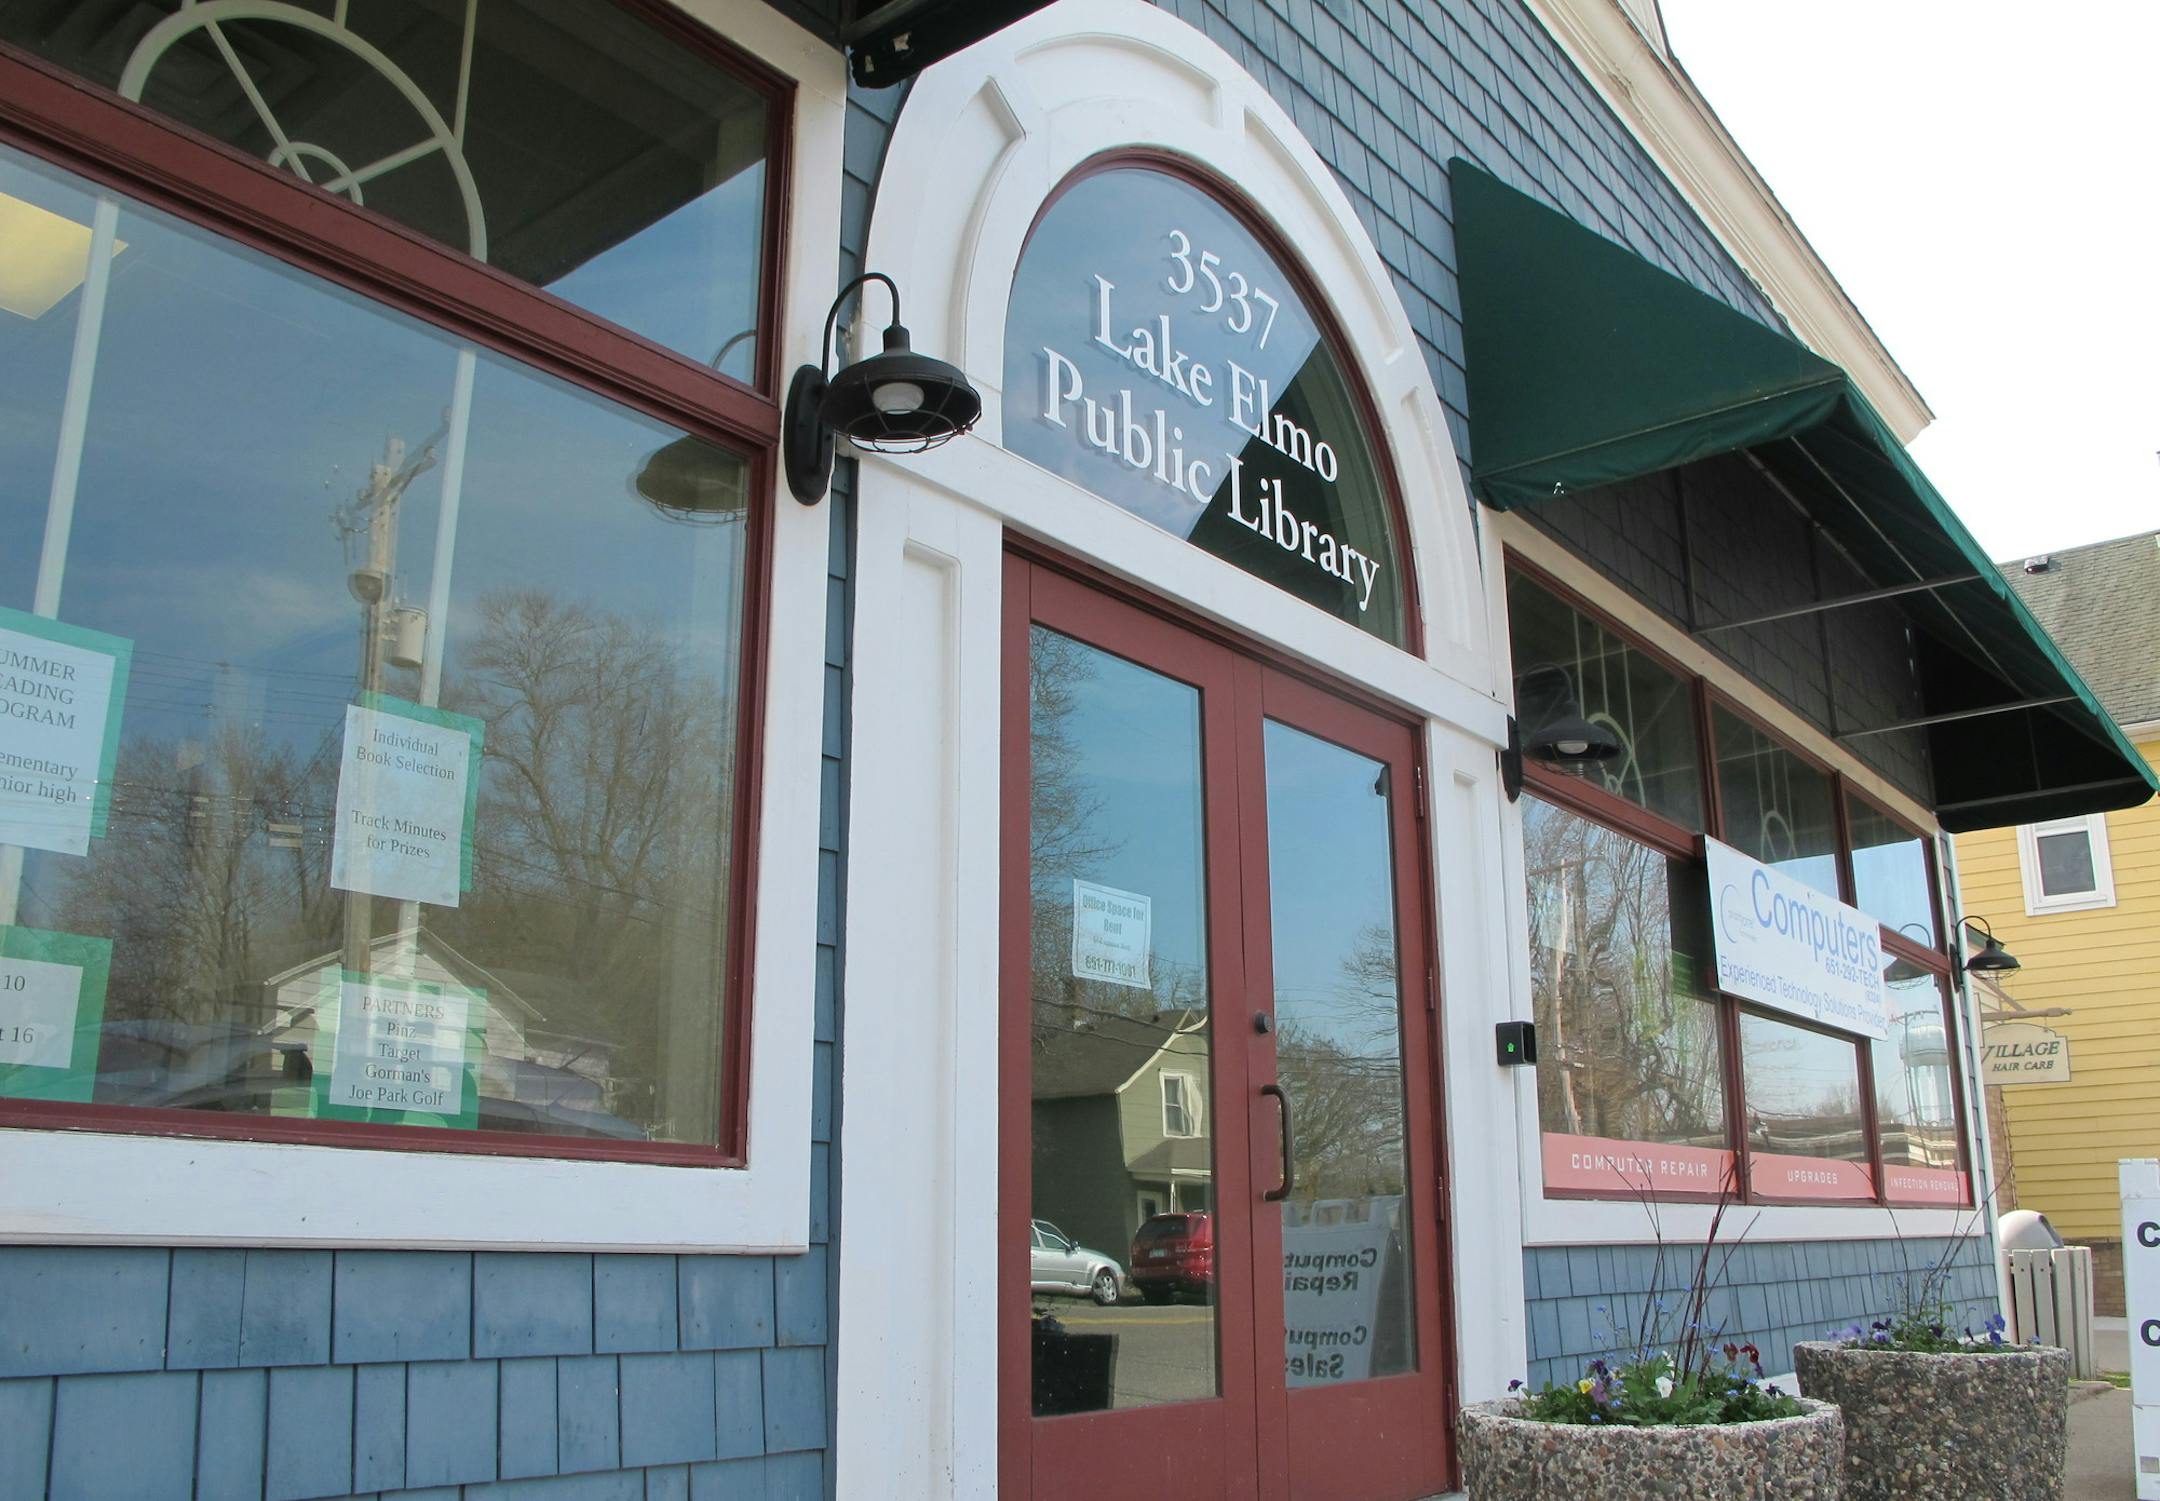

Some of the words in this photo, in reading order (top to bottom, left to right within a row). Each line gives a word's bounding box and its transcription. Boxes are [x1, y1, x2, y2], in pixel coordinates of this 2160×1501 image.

[1167, 229, 1280, 350] 3537
[1094, 273, 1213, 406] Lake
[1227, 360, 1338, 482] Elmo
[1043, 346, 1213, 504] Public
[1226, 453, 1380, 611] Library
[373, 728, 439, 757] Individual
[356, 746, 392, 766] Book
[396, 755, 455, 781] Selection
[38, 780, 77, 805] high
[352, 810, 390, 831] Track
[394, 818, 447, 841] Minutes
[367, 835, 387, 851] for
[391, 838, 431, 859] Prizes
[1751, 868, 1878, 972] Computers
[1720, 955, 1777, 994] Experienced
[362, 995, 445, 1019] PARTNERS
[12, 1026, 34, 1044] 16
[387, 1022, 417, 1039] Pinz
[378, 1042, 421, 1063] Target
[365, 1064, 431, 1084] Gorman's
[1992, 1062, 2020, 1072] HAIR
[2024, 1060, 2055, 1071] CARE
[348, 1084, 373, 1100] Joe
[377, 1087, 408, 1103] Park
[412, 1091, 445, 1106] Golf
[1571, 1153, 1653, 1174] COMPUTER
[1660, 1160, 1708, 1177] REPAIR
[1786, 1169, 1838, 1185] UPGRADES
